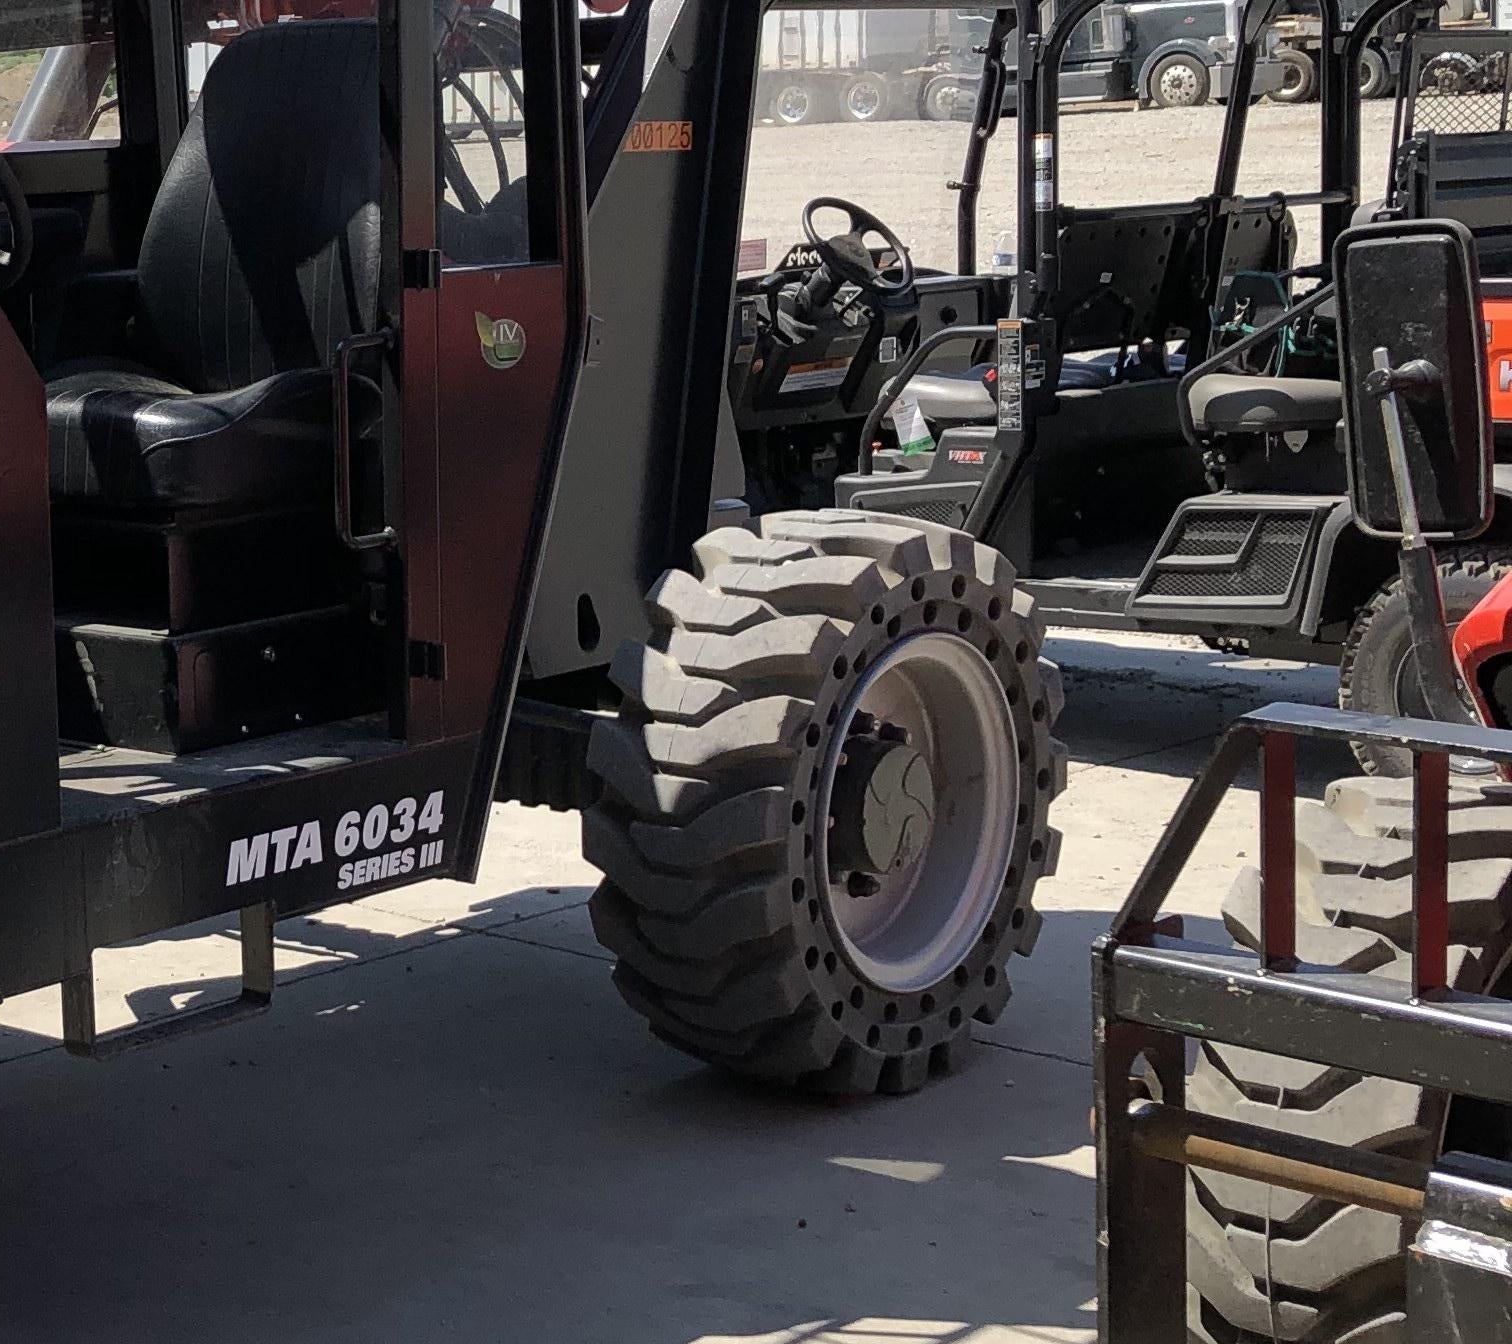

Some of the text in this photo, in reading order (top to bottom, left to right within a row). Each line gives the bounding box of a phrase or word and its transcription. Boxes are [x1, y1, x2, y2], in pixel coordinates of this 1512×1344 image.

[631, 122, 691, 149] 00125
[500, 323, 518, 342] IV
[226, 790, 444, 887] MTA 6034
[337, 840, 444, 890] SERIES III
